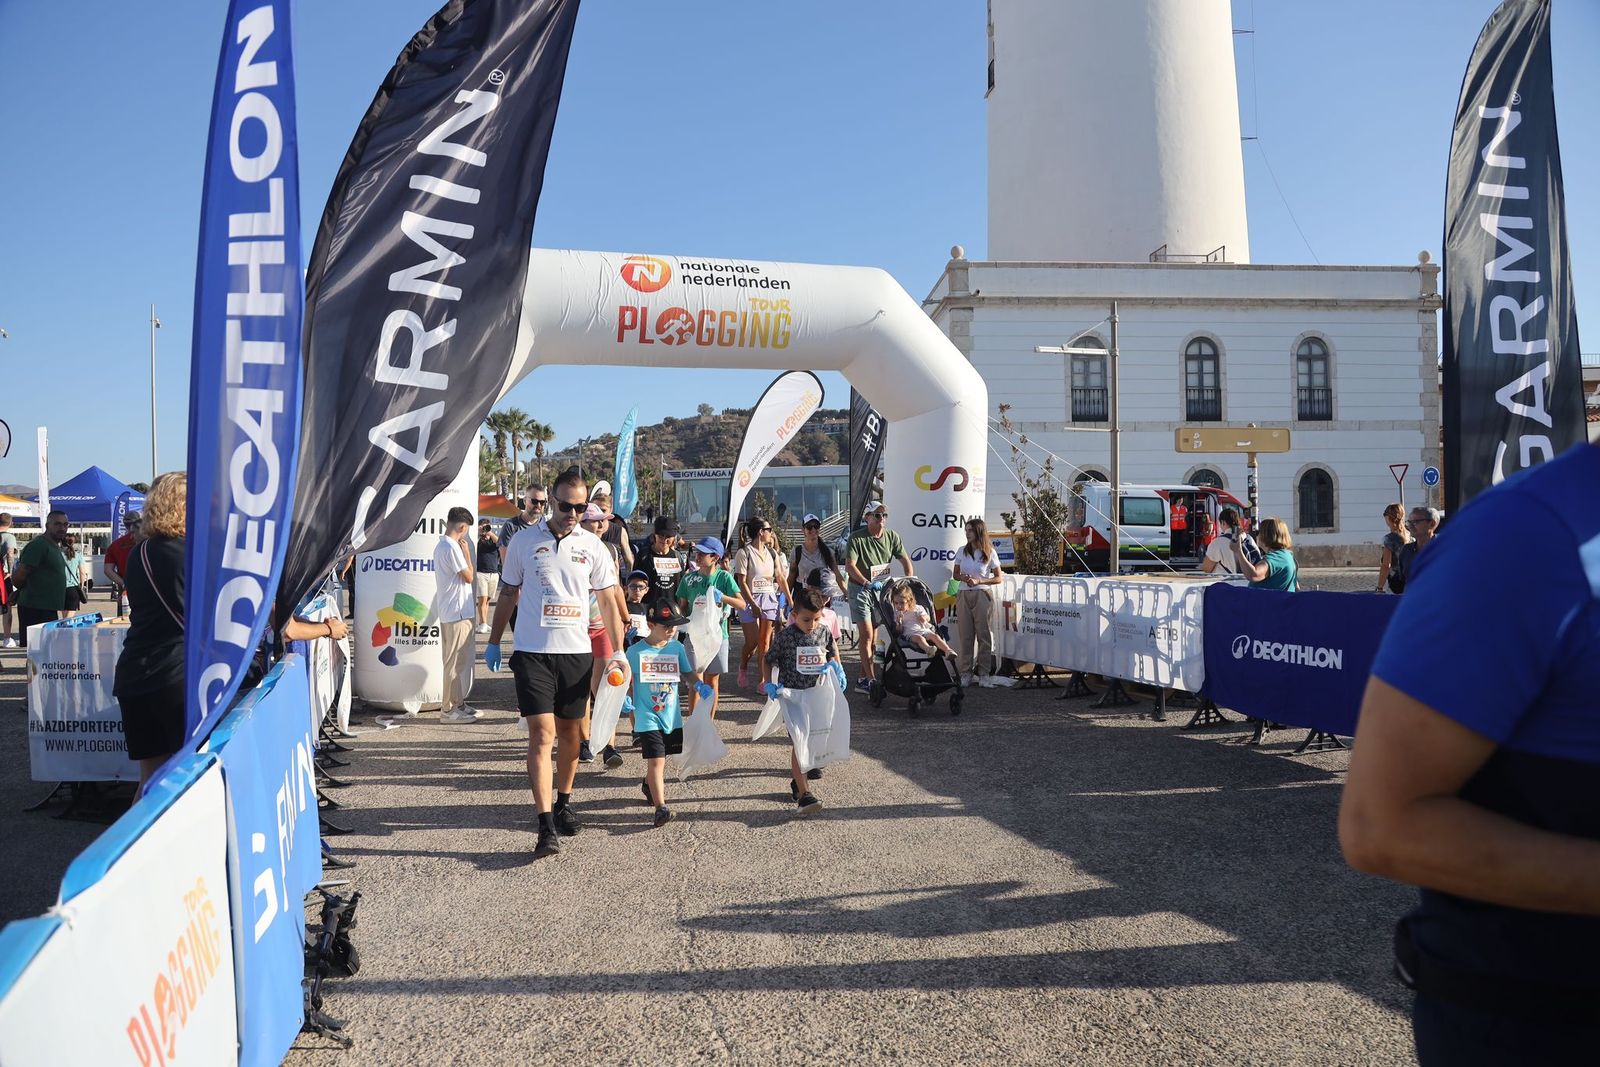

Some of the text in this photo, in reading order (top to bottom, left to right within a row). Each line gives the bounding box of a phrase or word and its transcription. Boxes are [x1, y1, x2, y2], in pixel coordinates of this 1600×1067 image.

[681, 262, 760, 274] nationale
[682, 273, 791, 290] nederlanden
[749, 297, 791, 312] TOUR
[214, 4, 286, 649] DECATHLON
[616, 305, 792, 349] PLOGGING
[862, 408, 882, 452] #B
[546, 606, 579, 616] 25077
[395, 622, 439, 637] Ibiza
[1253, 640, 1342, 670] DECATHLON
[41, 661, 86, 670] nationale
[645, 663, 675, 672] 25146
[41, 672, 101, 680] nederlanden
